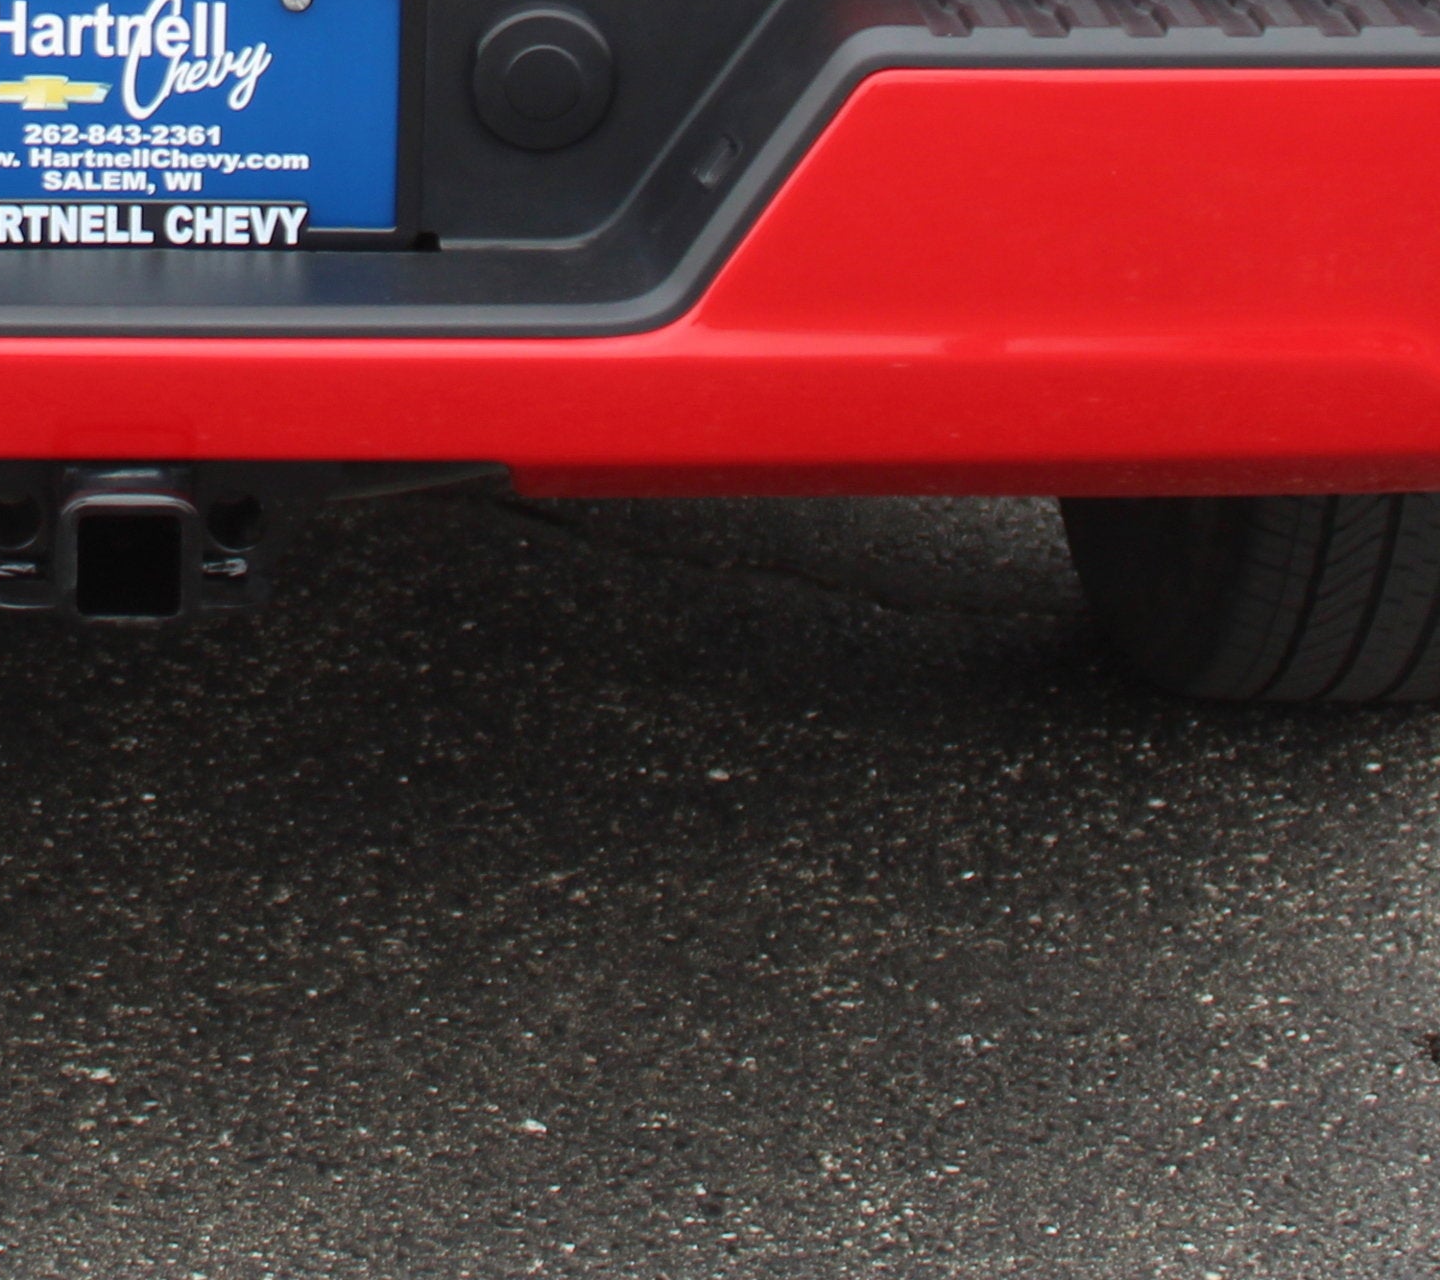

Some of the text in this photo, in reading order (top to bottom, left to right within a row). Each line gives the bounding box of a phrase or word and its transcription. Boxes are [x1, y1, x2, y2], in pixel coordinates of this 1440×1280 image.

[22, 123, 222, 146] 262-843-2361
[29, 147, 310, 174] HartnellChevy.com
[41, 171, 203, 195] SALEM, WI
[163, 204, 309, 246] CHEVY
